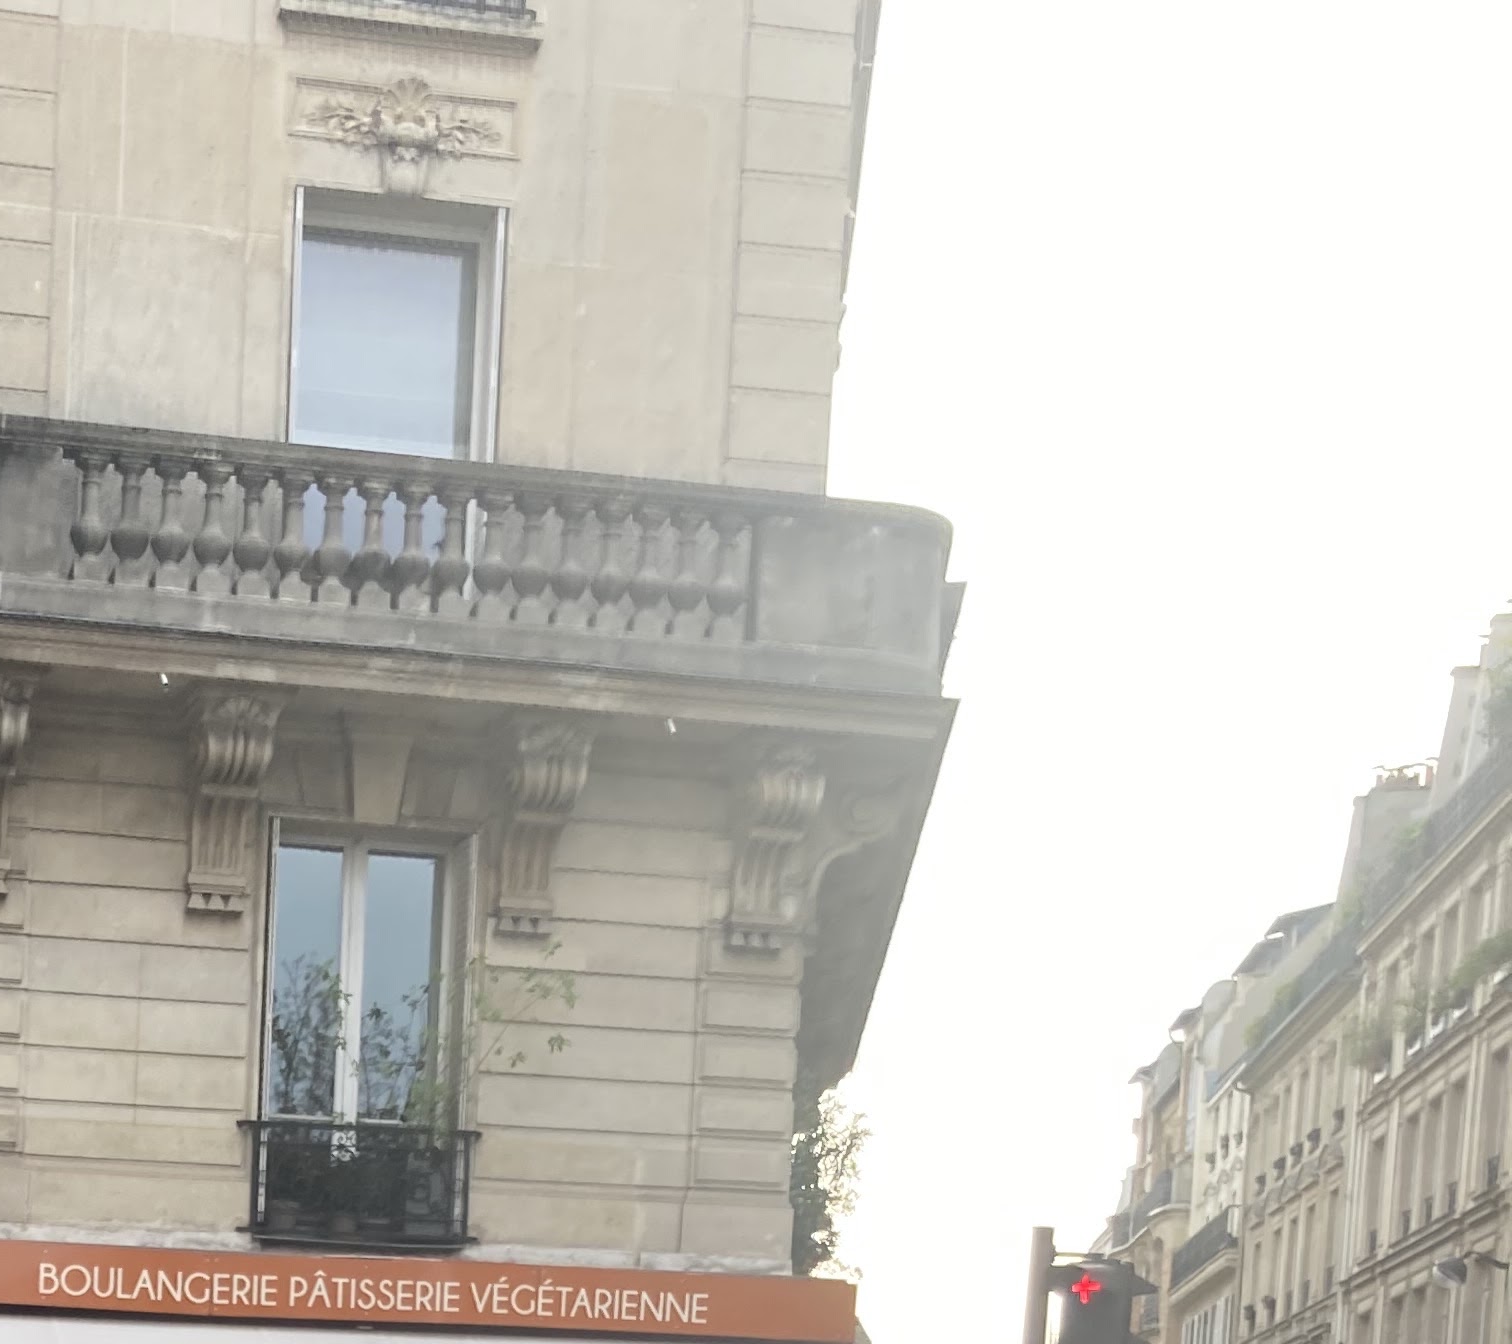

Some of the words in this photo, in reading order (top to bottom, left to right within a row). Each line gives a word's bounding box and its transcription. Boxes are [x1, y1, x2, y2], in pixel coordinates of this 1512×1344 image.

[39, 1263, 279, 1307] BOULANGERIE
[288, 1270, 461, 1313] PÂTISSERIE
[471, 1277, 709, 1324] VÉGÉTARIENNE
